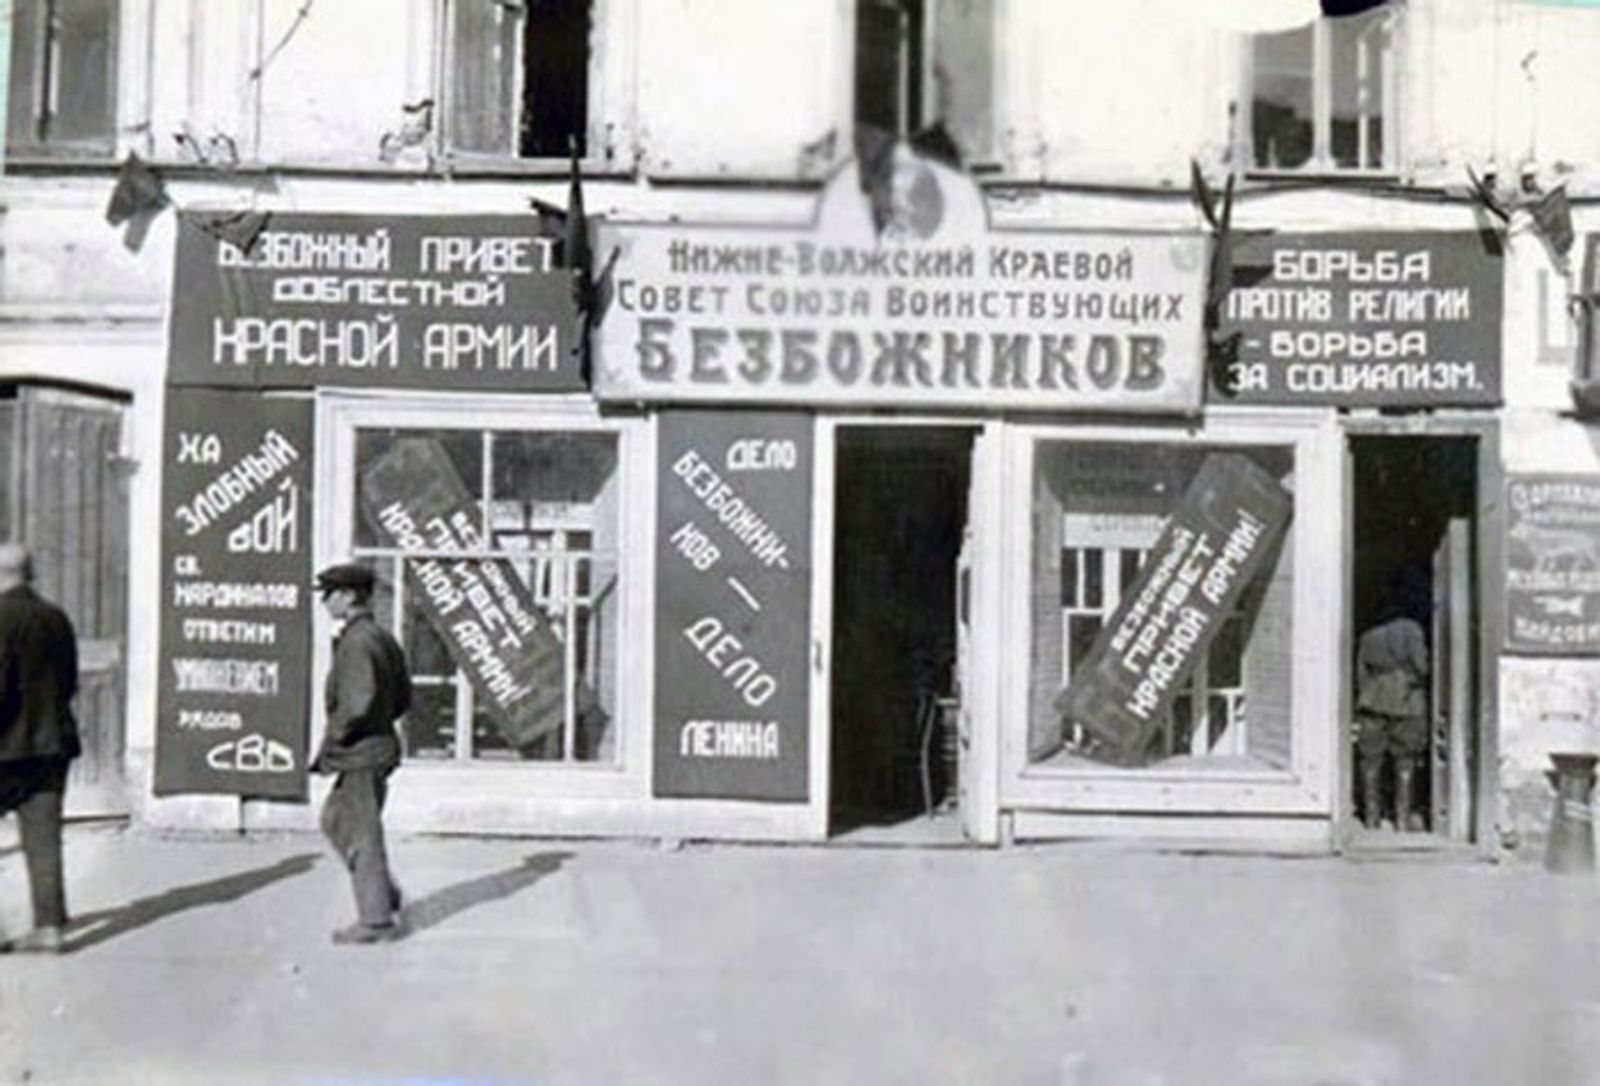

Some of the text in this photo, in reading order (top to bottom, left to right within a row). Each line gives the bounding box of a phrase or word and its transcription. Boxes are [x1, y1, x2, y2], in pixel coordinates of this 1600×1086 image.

[420, 236, 553, 273] ПРИВЕТ
[989, 247, 1134, 281] КРАЕВОЙ
[1273, 249, 1430, 281] БОРЬБА
[272, 275, 507, 307] ДОБЛЕСТНОЙ
[618, 279, 1184, 325] СОВЕТ СОЮЗА ВОИНСТВУЮЩИХ
[1227, 287, 1471, 322] ПРОТИВ РЕЛИГИИ
[213, 313, 559, 371] КРАСНОЙ АРМИИ
[635, 317, 1167, 392] БЕЗБОЖНИКОВ
[1270, 331, 1428, 358] БОРЬБА
[1228, 363, 1484, 393] ЗА СОЦИАЛИЗМ.
[726, 439, 797, 471] ДЕЛО
[175, 429, 299, 536] ЗЛОБНЫЙ
[669, 521, 721, 571] КОВ
[683, 616, 777, 708] ДЕЛО
[680, 720, 780, 759] ЛЕНИНА
